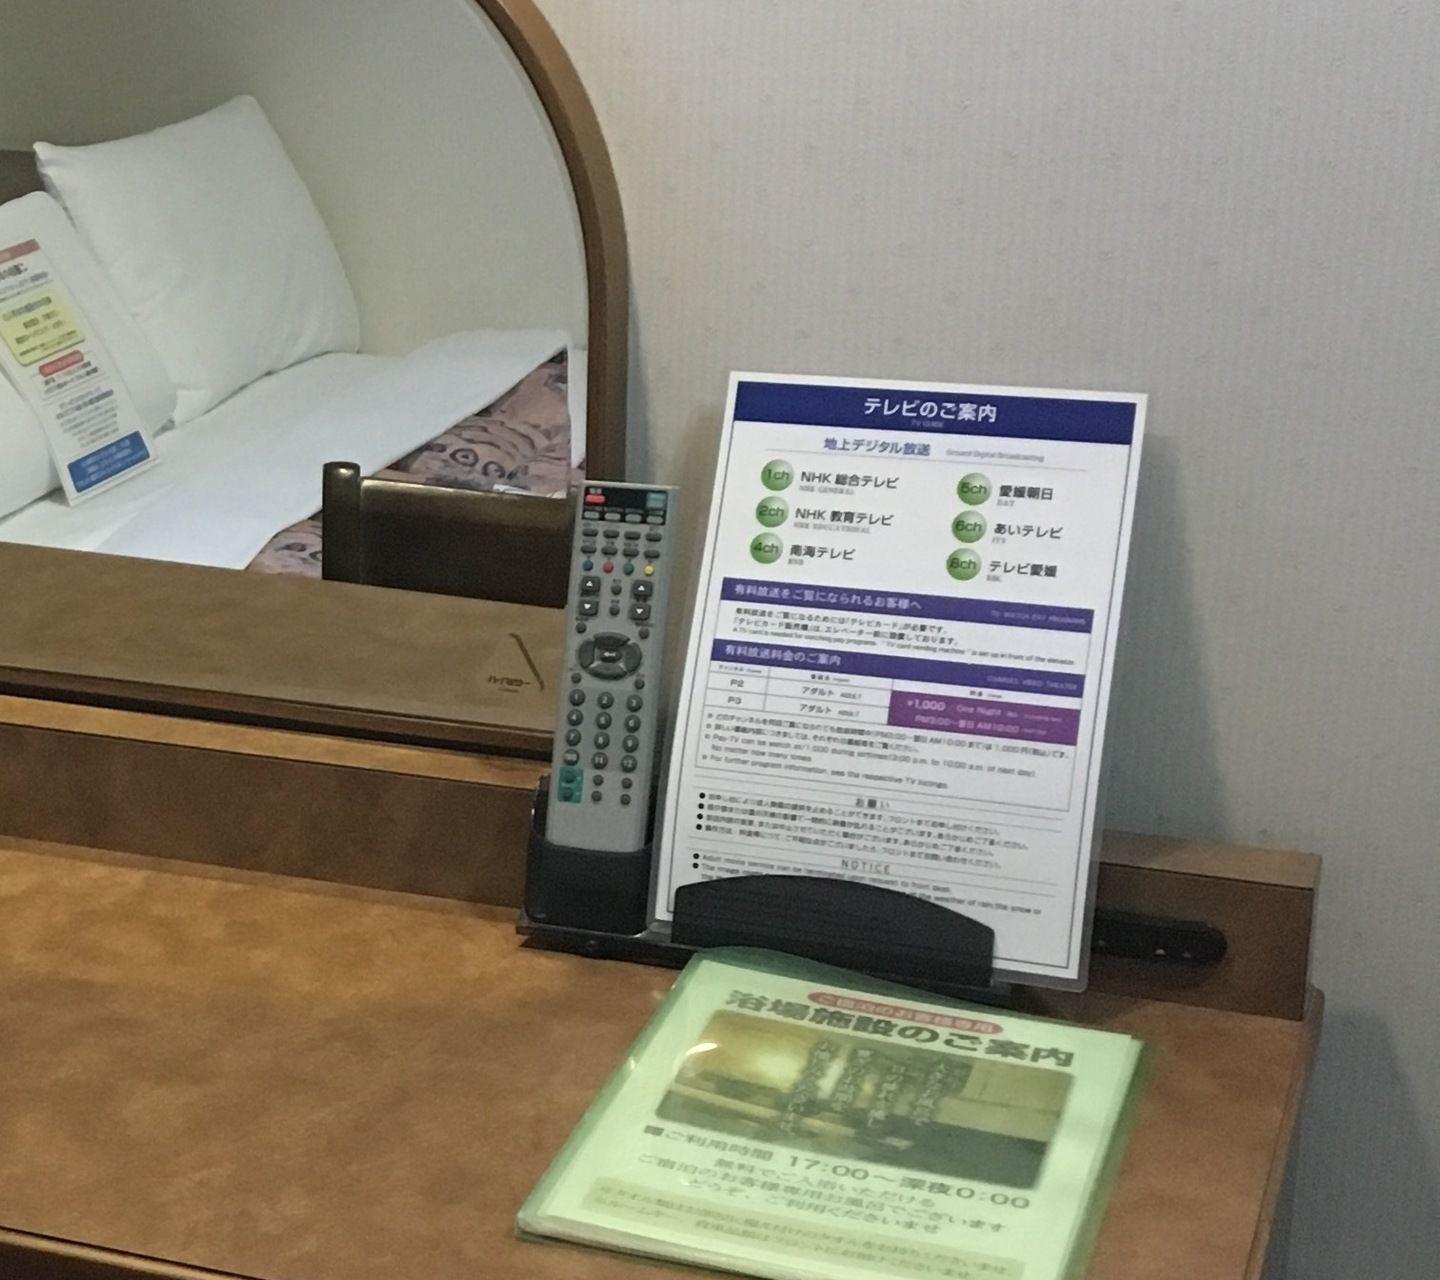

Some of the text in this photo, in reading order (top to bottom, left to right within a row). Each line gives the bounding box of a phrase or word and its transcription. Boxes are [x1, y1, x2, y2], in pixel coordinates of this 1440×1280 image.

[862, 397, 998, 423] テレビのご案内
[824, 437, 931, 457] 地上デジタル放送
[766, 468, 790, 480] 1ch
[800, 471, 899, 489] NHK 総合テレビ
[959, 481, 987, 494] 5ch
[998, 484, 1053, 500] 愛媛朝日
[758, 505, 784, 517] 2ch
[795, 507, 894, 526] NHK 教育テレビ
[954, 519, 982, 532] 6ch
[993, 522, 1063, 539] あいテレビ
[752, 541, 779, 554] 4ch
[789, 544, 855, 560] 南海テレビ
[948, 557, 977, 570] 8ch
[988, 560, 1057, 577] テレビ愛媛
[725, 643, 841, 666] 有料放送料金のご案内
[729, 678, 744, 687] P2
[801, 686, 834, 696] アダルト
[727, 695, 742, 704] P3
[799, 703, 832, 714] アダルト
[840, 859, 890, 874] NOTICE
[725, 989, 1075, 1068] 浴場施設のご案内
